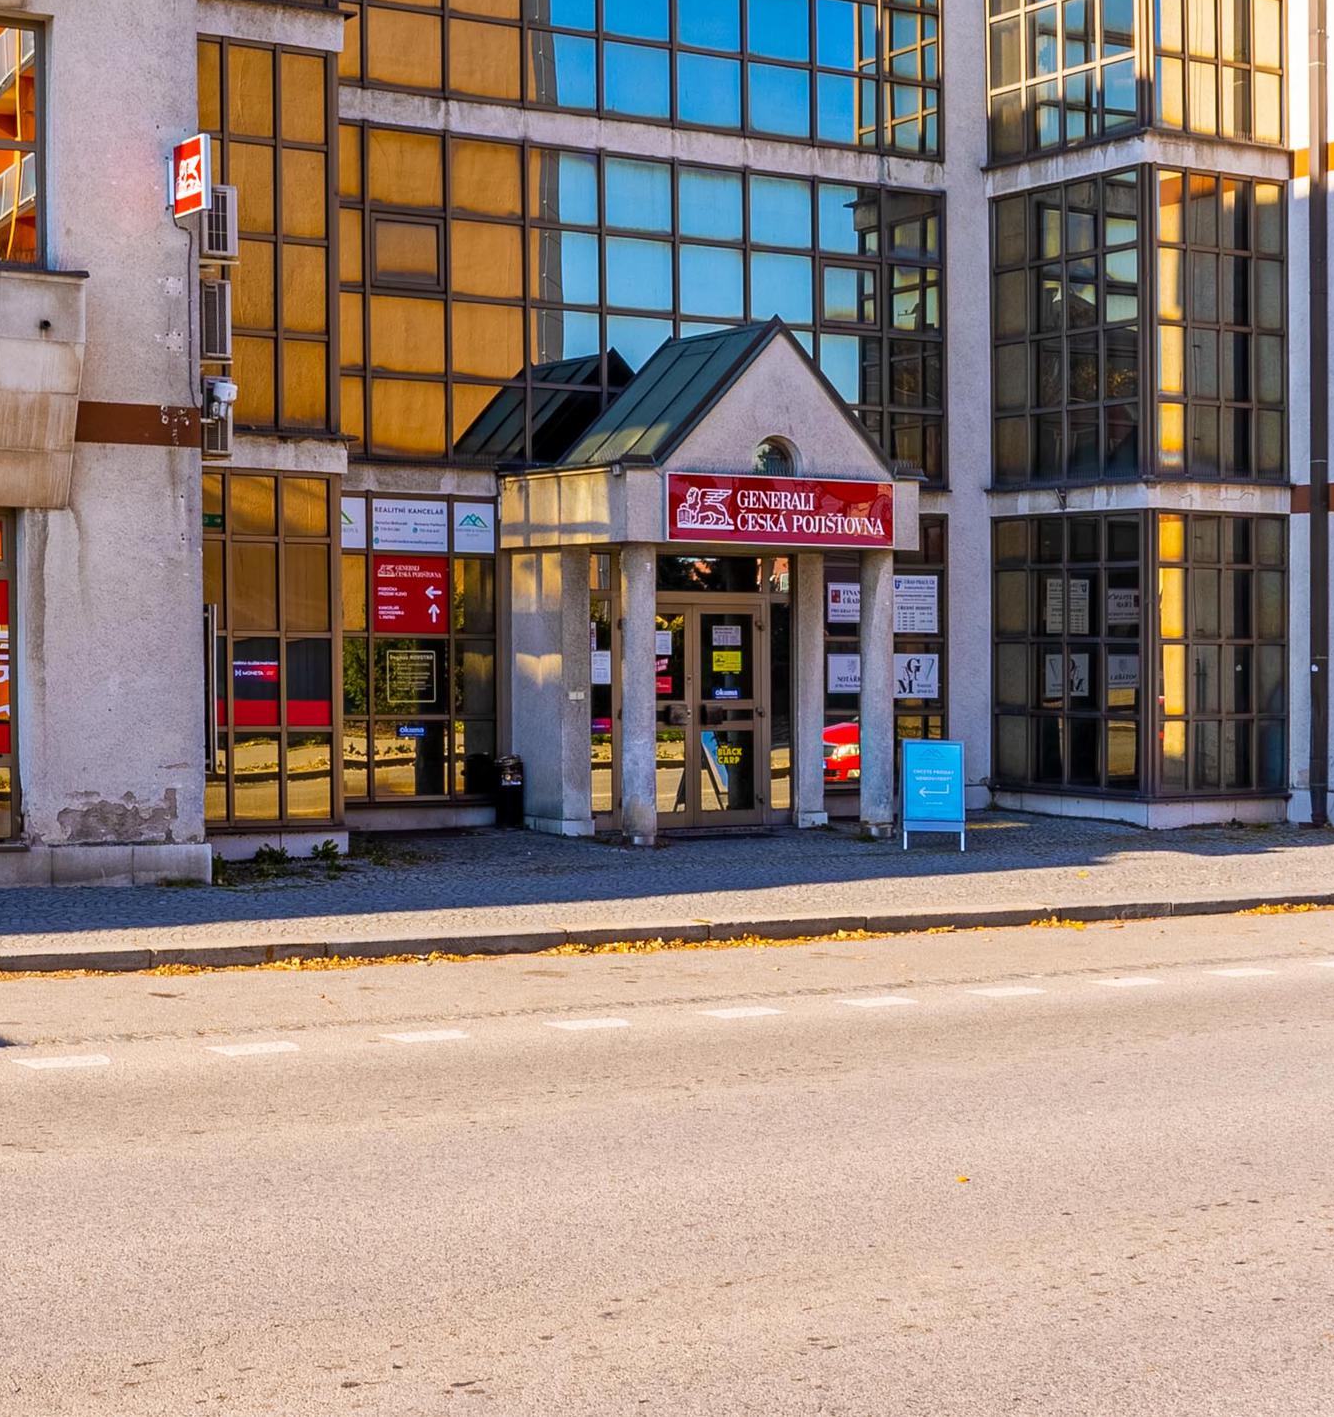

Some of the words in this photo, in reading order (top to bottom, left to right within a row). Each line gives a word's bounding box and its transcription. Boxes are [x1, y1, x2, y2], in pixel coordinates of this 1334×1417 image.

[737, 489, 815, 511] GENERALI
[374, 506, 406, 514] REALITNÍ
[737, 509, 788, 533] ČESKÁ
[792, 513, 885, 536] POJIŠŤOVNA
[717, 747, 743, 756] BLACK
[718, 756, 740, 765] CARP
